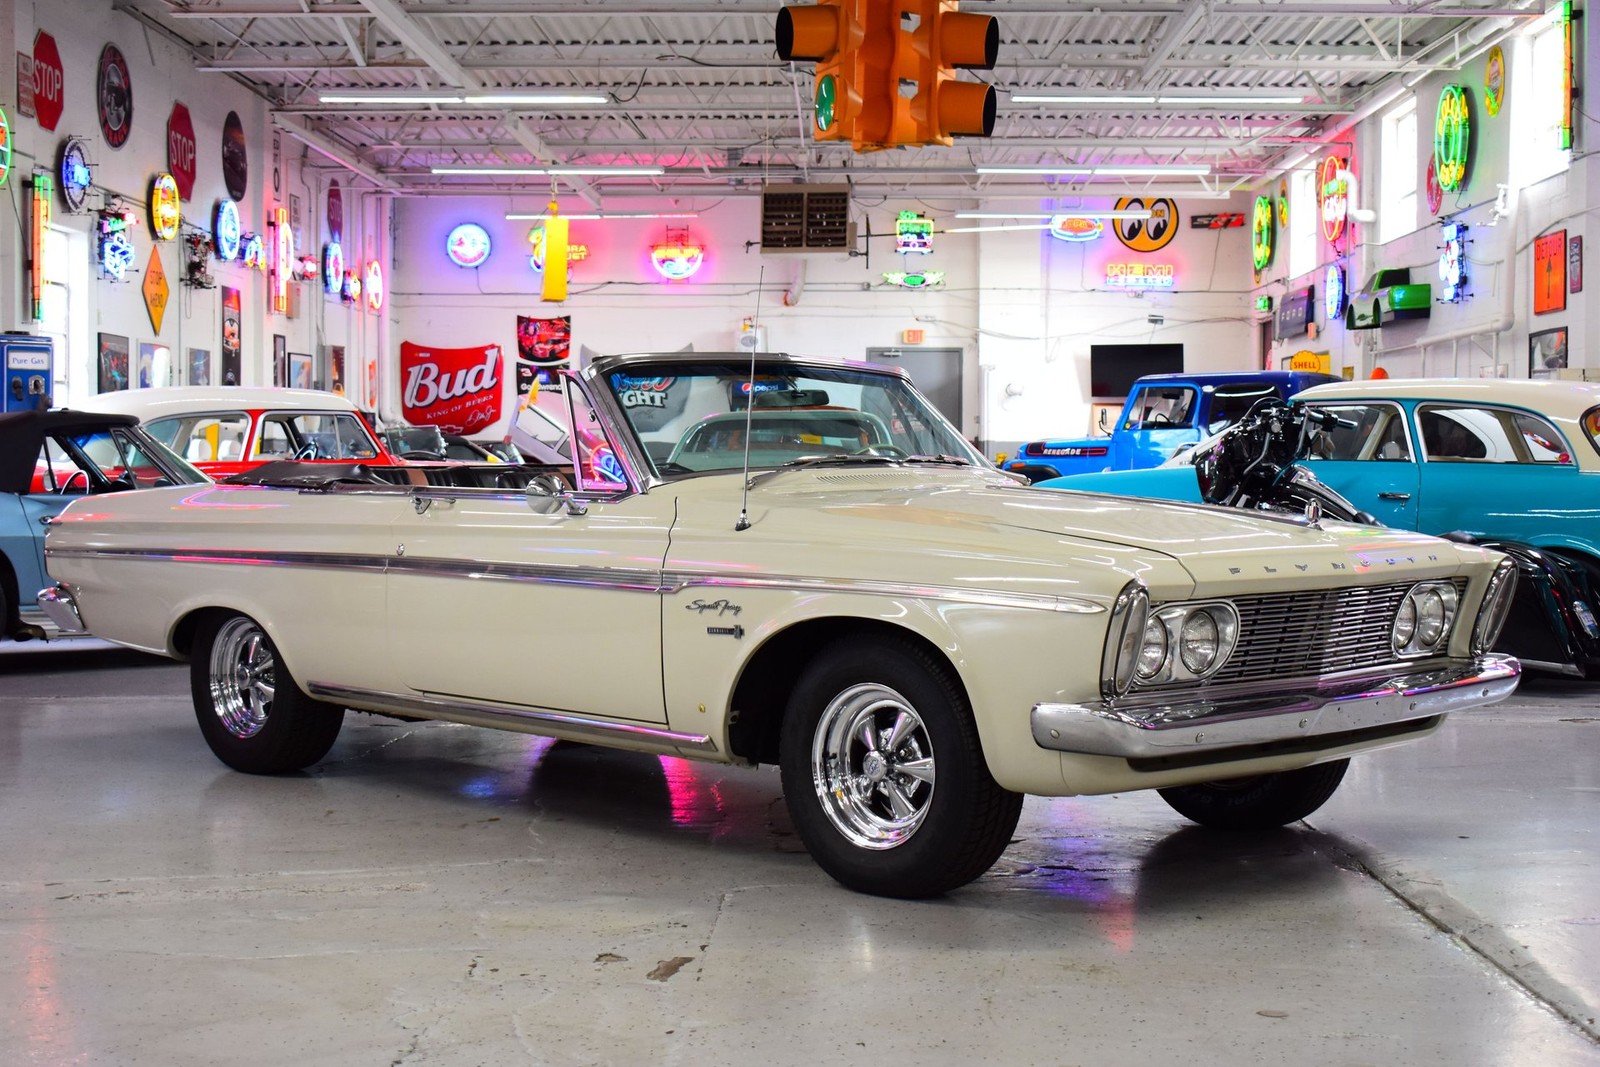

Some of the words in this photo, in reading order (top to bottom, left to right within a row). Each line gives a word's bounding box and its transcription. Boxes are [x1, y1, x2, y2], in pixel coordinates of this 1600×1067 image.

[33, 59, 61, 103] STOP
[170, 130, 195, 173] STOP
[1536, 236, 1563, 262] DETOUR
[1107, 264, 1173, 277] HEMI
[1281, 307, 1303, 320] FORD
[12, 357, 28, 365] Pure
[31, 357, 45, 365] Gas
[1294, 361, 1317, 369] SHELL
[404, 348, 498, 409] Bud
[521, 367, 533, 377] 3
[754, 384, 779, 392] pepsi
[426, 409, 449, 419] KING
[451, 404, 462, 412] OF
[465, 394, 494, 408] BEERS
[1043, 448, 1081, 456] RENEGADE
[1228, 554, 1438, 575] PLYMOUTH
